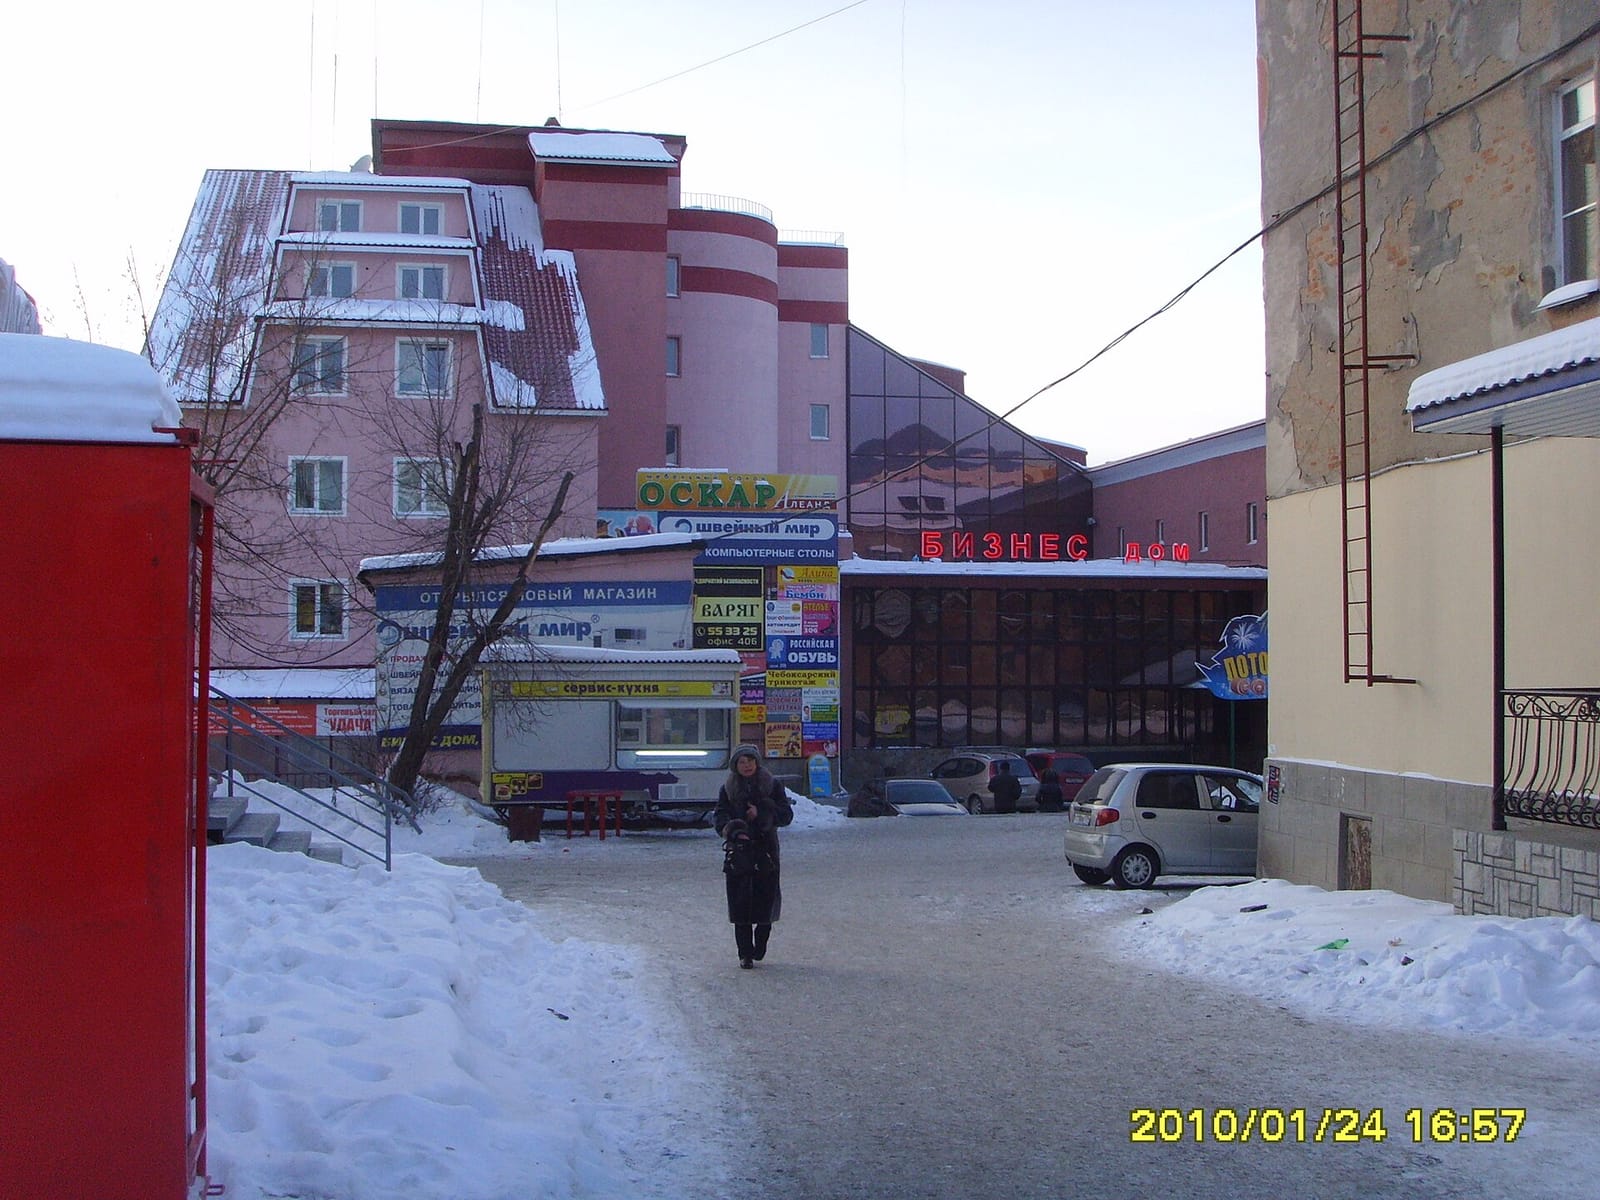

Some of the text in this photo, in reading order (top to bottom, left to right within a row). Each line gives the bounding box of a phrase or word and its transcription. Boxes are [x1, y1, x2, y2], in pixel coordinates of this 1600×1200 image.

[639, 481, 777, 509] ОСКАР
[696, 519, 820, 538] швейный мир
[705, 547, 835, 559] КОМПЬЮТЕРНЫЕ СТОЛЫ
[921, 531, 1190, 563] БИЗНЕС ДОМ
[420, 587, 657, 603] ОТРЫЛСЯ ОВЫЙ МАГАЗИН
[702, 603, 760, 617] ВАРЯГ
[539, 621, 592, 641] мир
[707, 627, 758, 636] 55 33 25
[707, 637, 757, 646] офис 406
[790, 638, 835, 649] РОССИЙСКАЯ
[788, 651, 837, 663] ОБУВЬ
[768, 670, 836, 679] Чебоксарский
[563, 683, 660, 695] сервис-кухня
